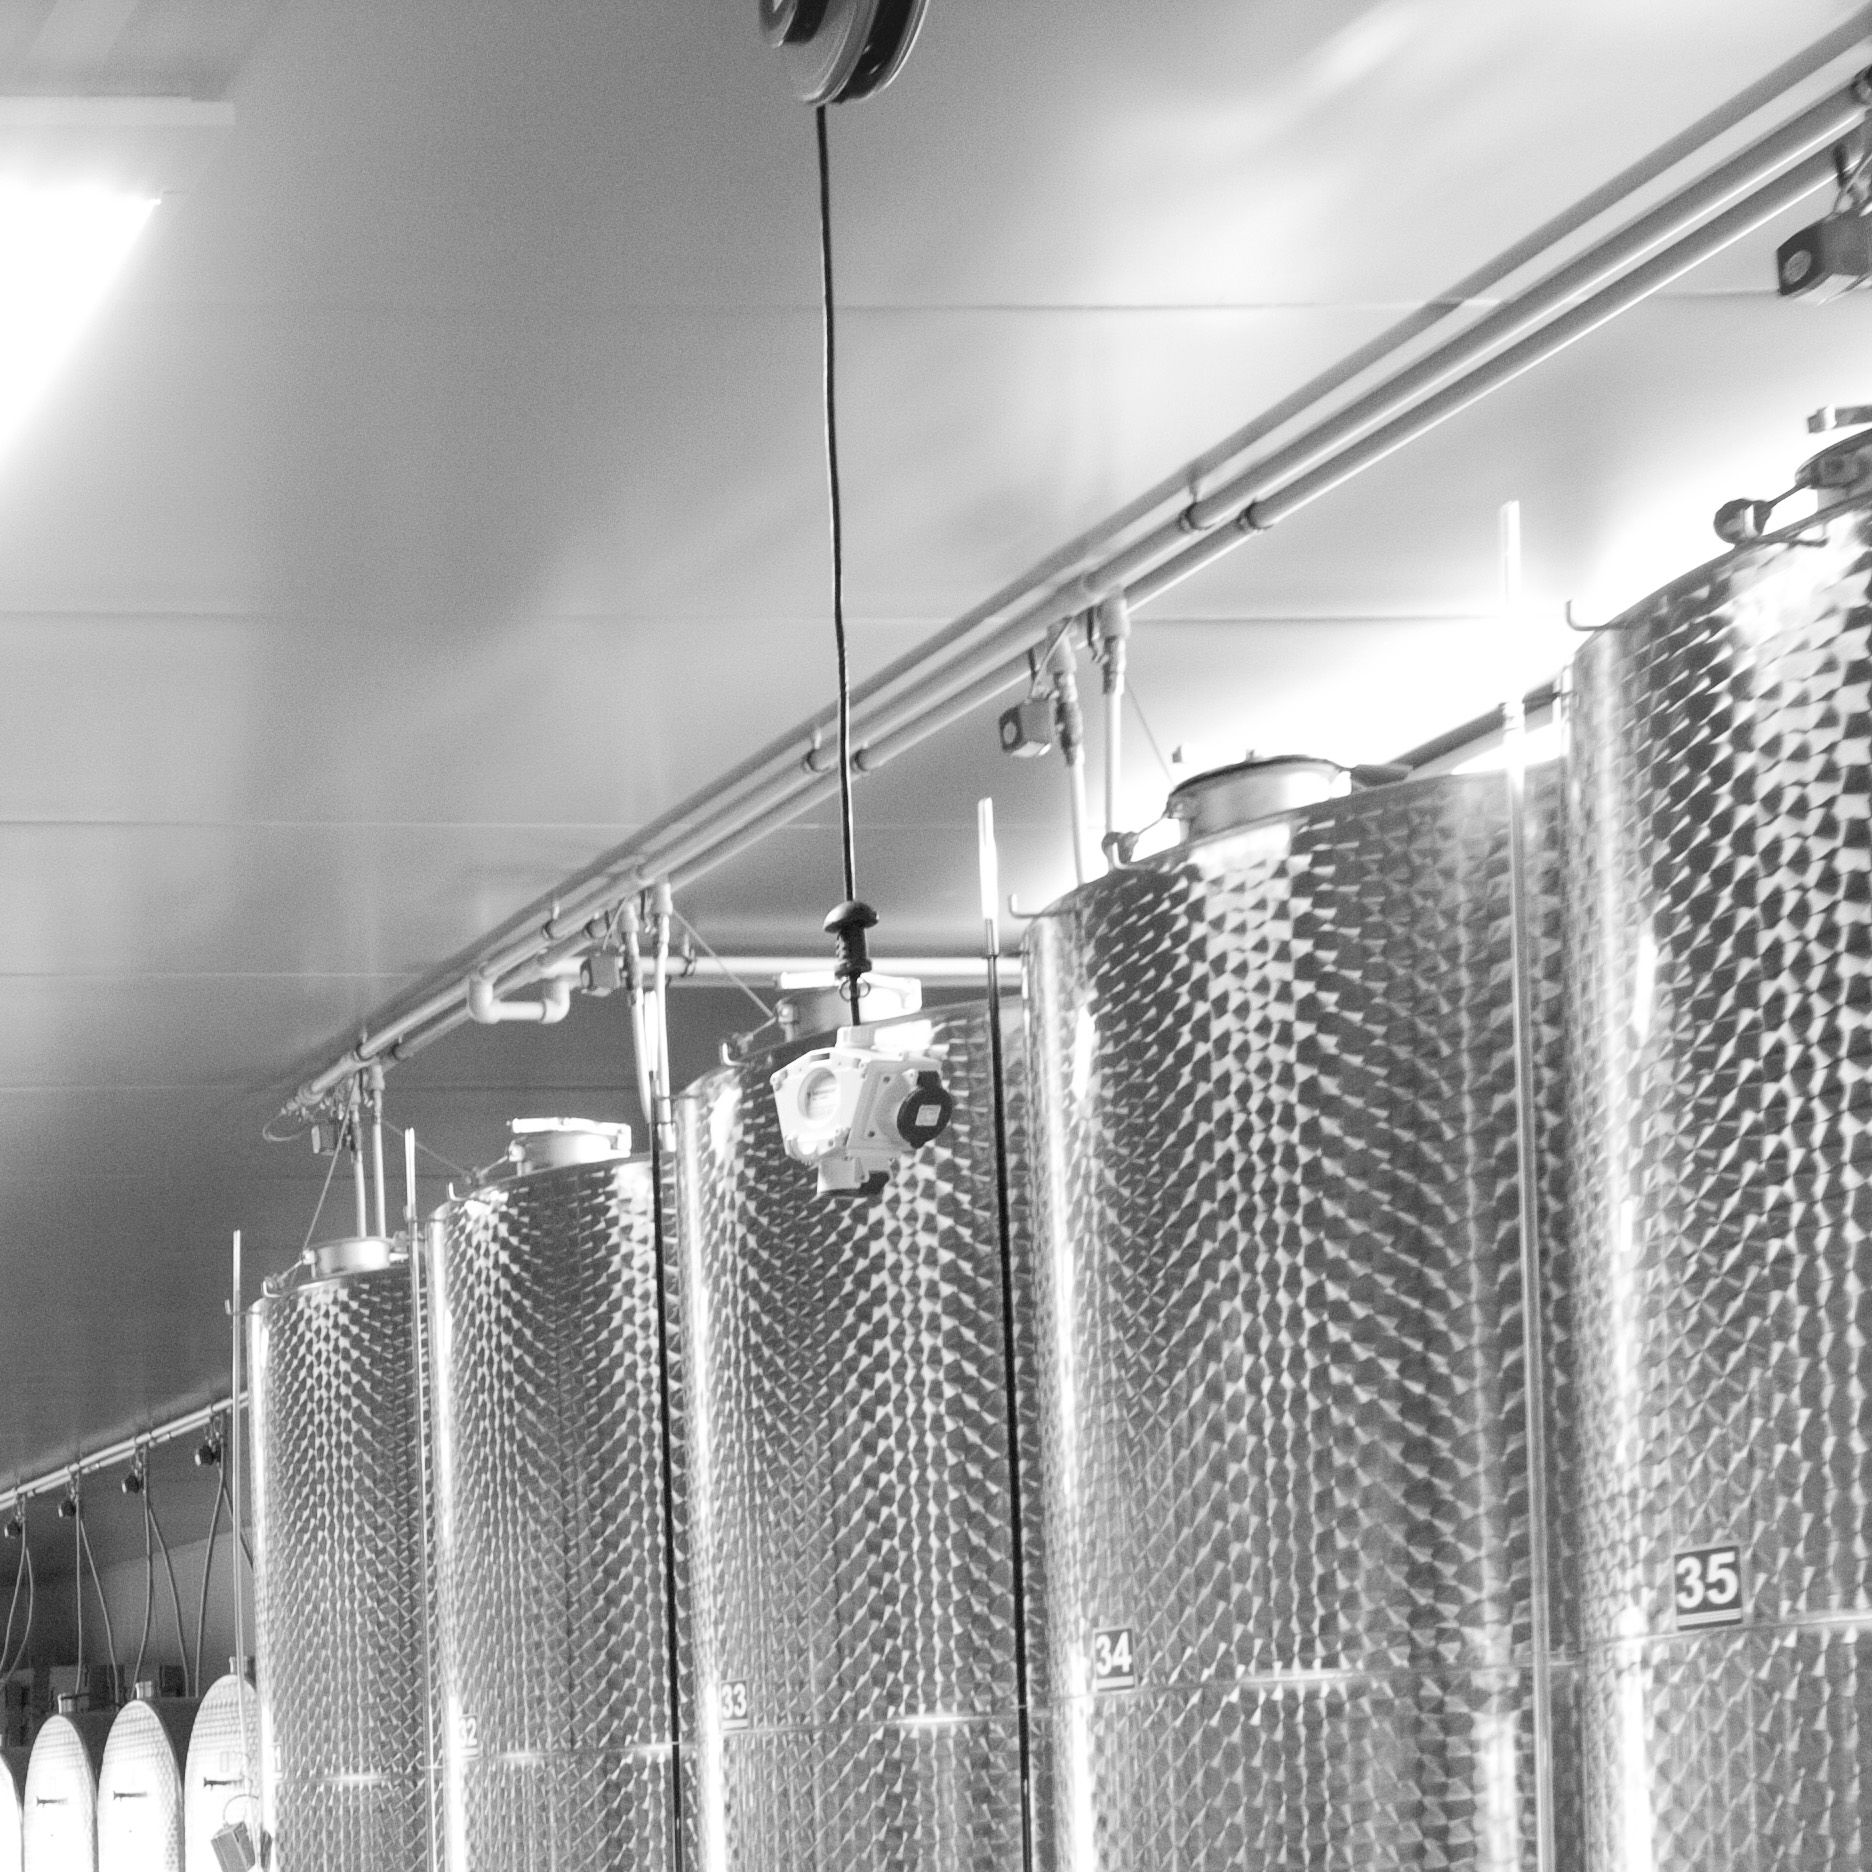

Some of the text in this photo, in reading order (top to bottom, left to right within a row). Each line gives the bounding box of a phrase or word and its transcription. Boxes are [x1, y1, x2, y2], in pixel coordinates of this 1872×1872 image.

[1676, 1551, 1738, 1609] 35
[1096, 1630, 1133, 1676] 34
[721, 1682, 747, 1719] 33
